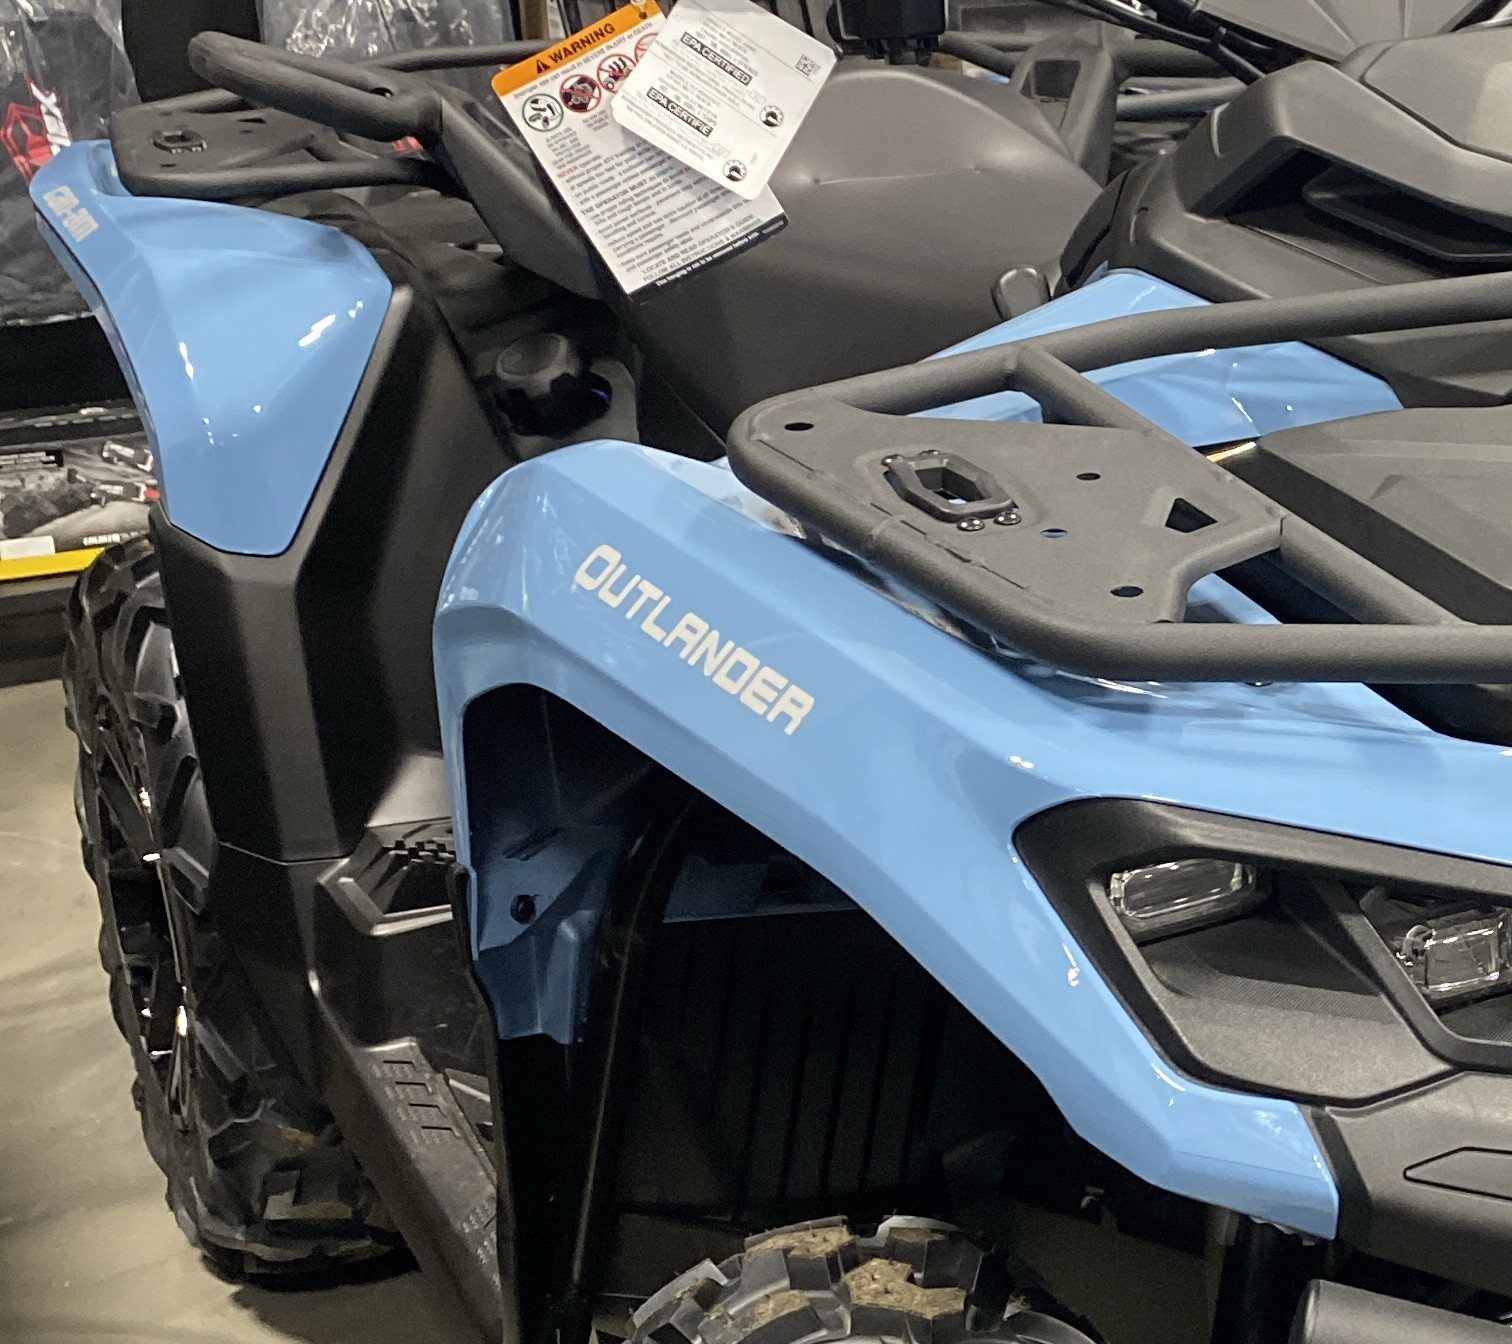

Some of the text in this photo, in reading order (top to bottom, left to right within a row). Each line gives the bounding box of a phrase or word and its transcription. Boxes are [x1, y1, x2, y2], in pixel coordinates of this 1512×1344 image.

[548, 21, 616, 65] WARNING
[680, 33, 704, 52] EPA
[699, 46, 752, 85] CERTIFIED
[646, 88, 670, 107] EPA
[574, 544, 815, 735] OUTLANDER
